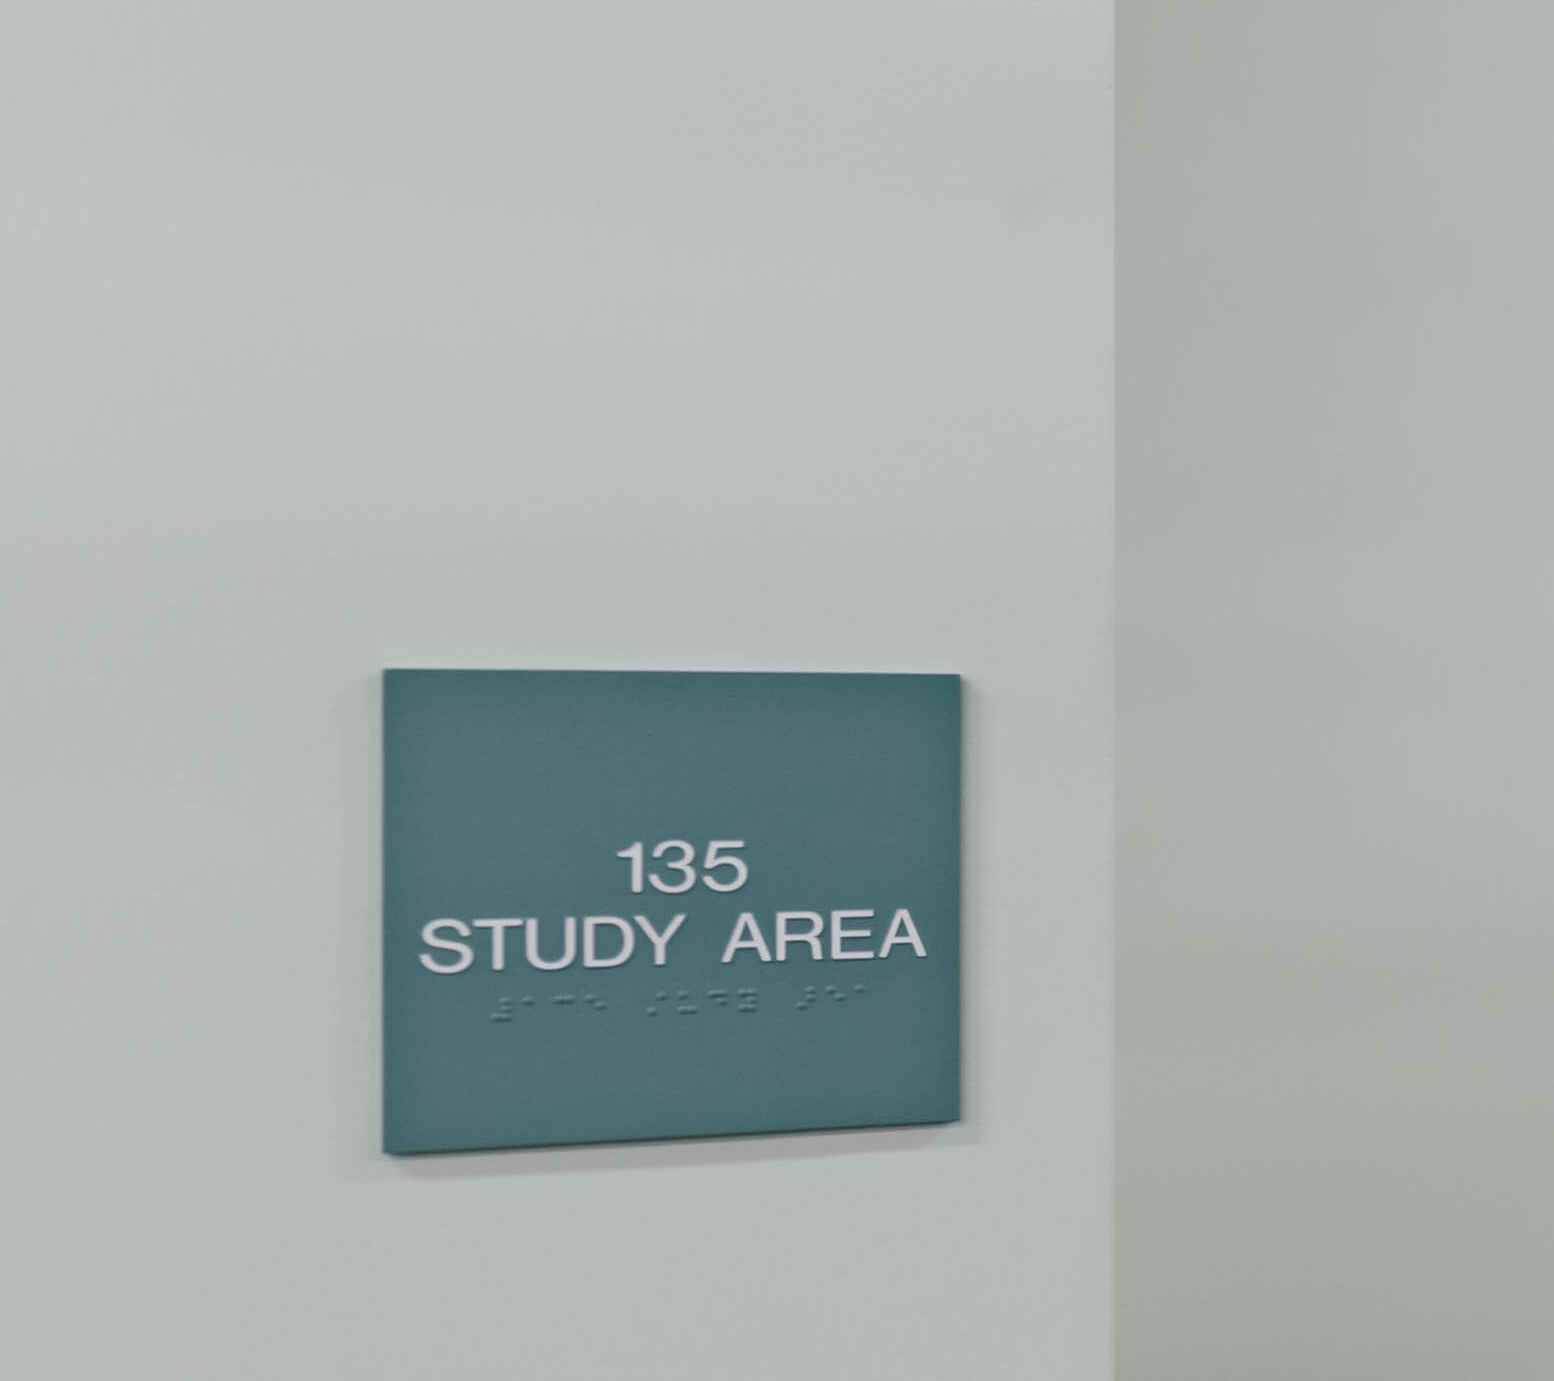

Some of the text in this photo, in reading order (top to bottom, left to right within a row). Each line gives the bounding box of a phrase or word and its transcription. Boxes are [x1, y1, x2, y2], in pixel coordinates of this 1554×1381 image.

[616, 839, 749, 894] 135
[418, 908, 928, 975] STUDY AREA
